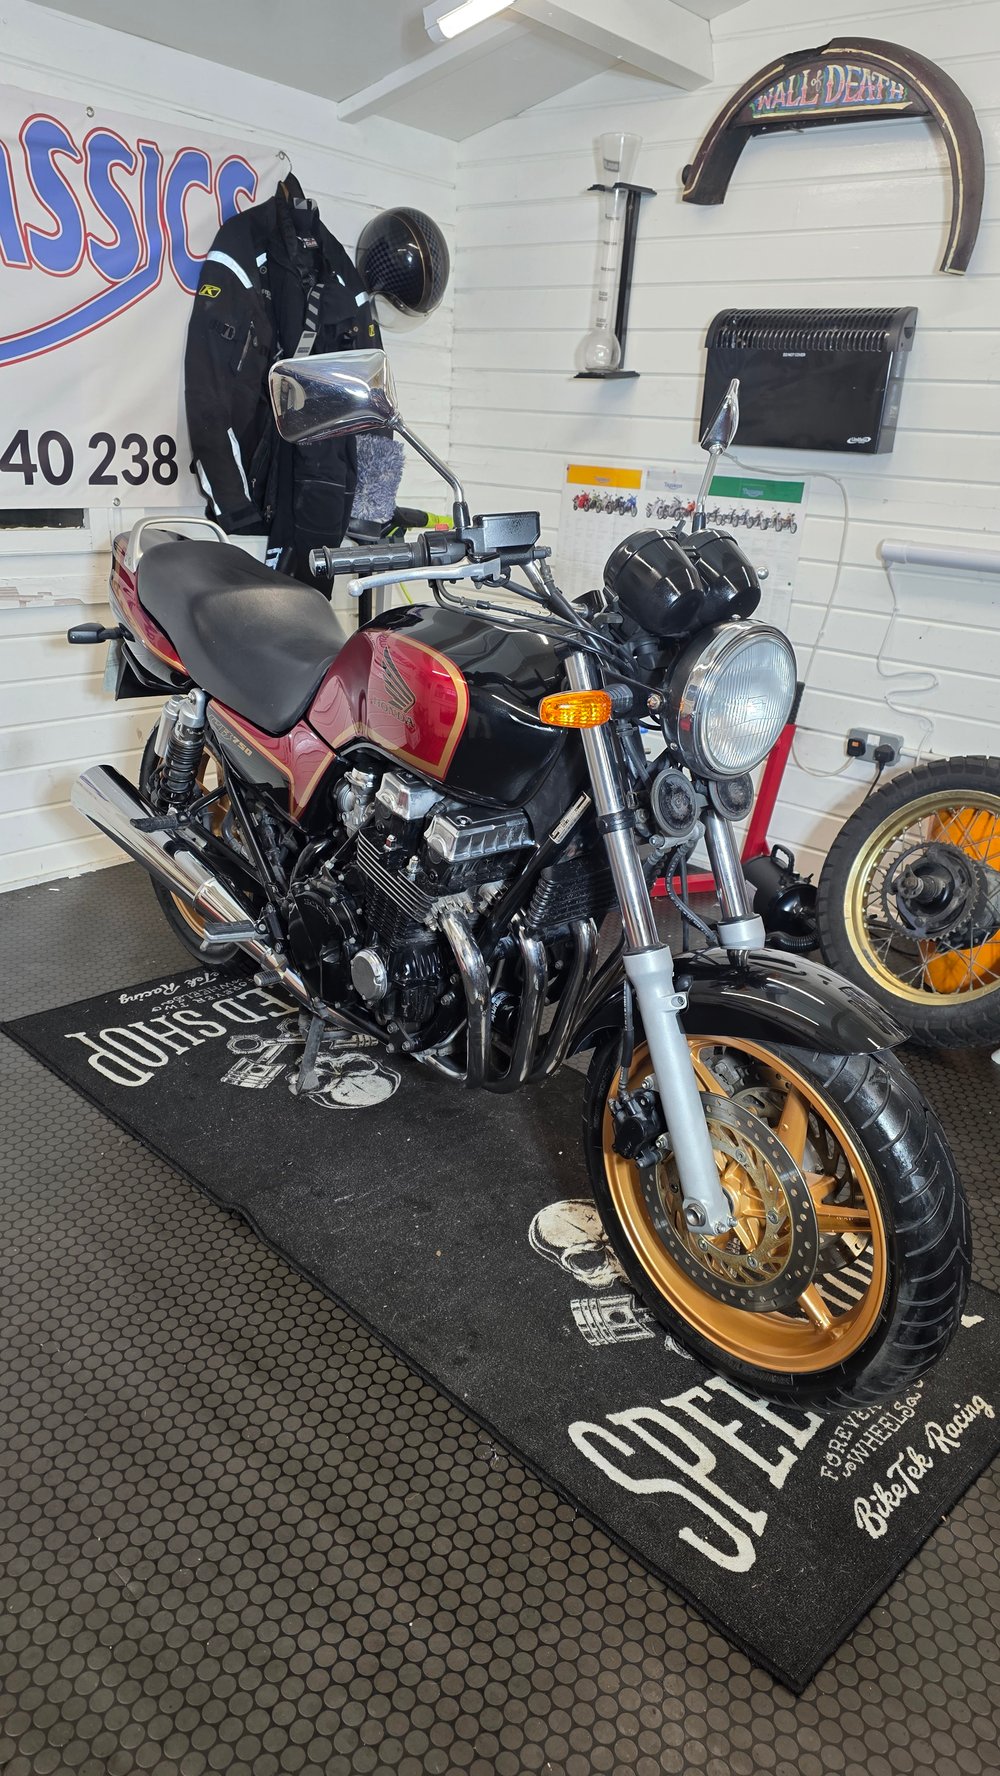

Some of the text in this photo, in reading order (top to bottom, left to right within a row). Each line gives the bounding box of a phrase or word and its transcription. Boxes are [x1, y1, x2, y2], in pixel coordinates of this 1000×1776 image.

[757, 64, 905, 110] WALL of DEATH
[0, 429, 179, 486] 40 238
[369, 699, 416, 730] HONDA
[118, 982, 180, 1004] Racing
[152, 1003, 189, 1013] TWO
[64, 1009, 227, 1087] SHOP
[851, 1400, 915, 1464] WHEELS
[568, 1376, 824, 1572] SPEE
[854, 1395, 996, 1539] BikeTek Racing
